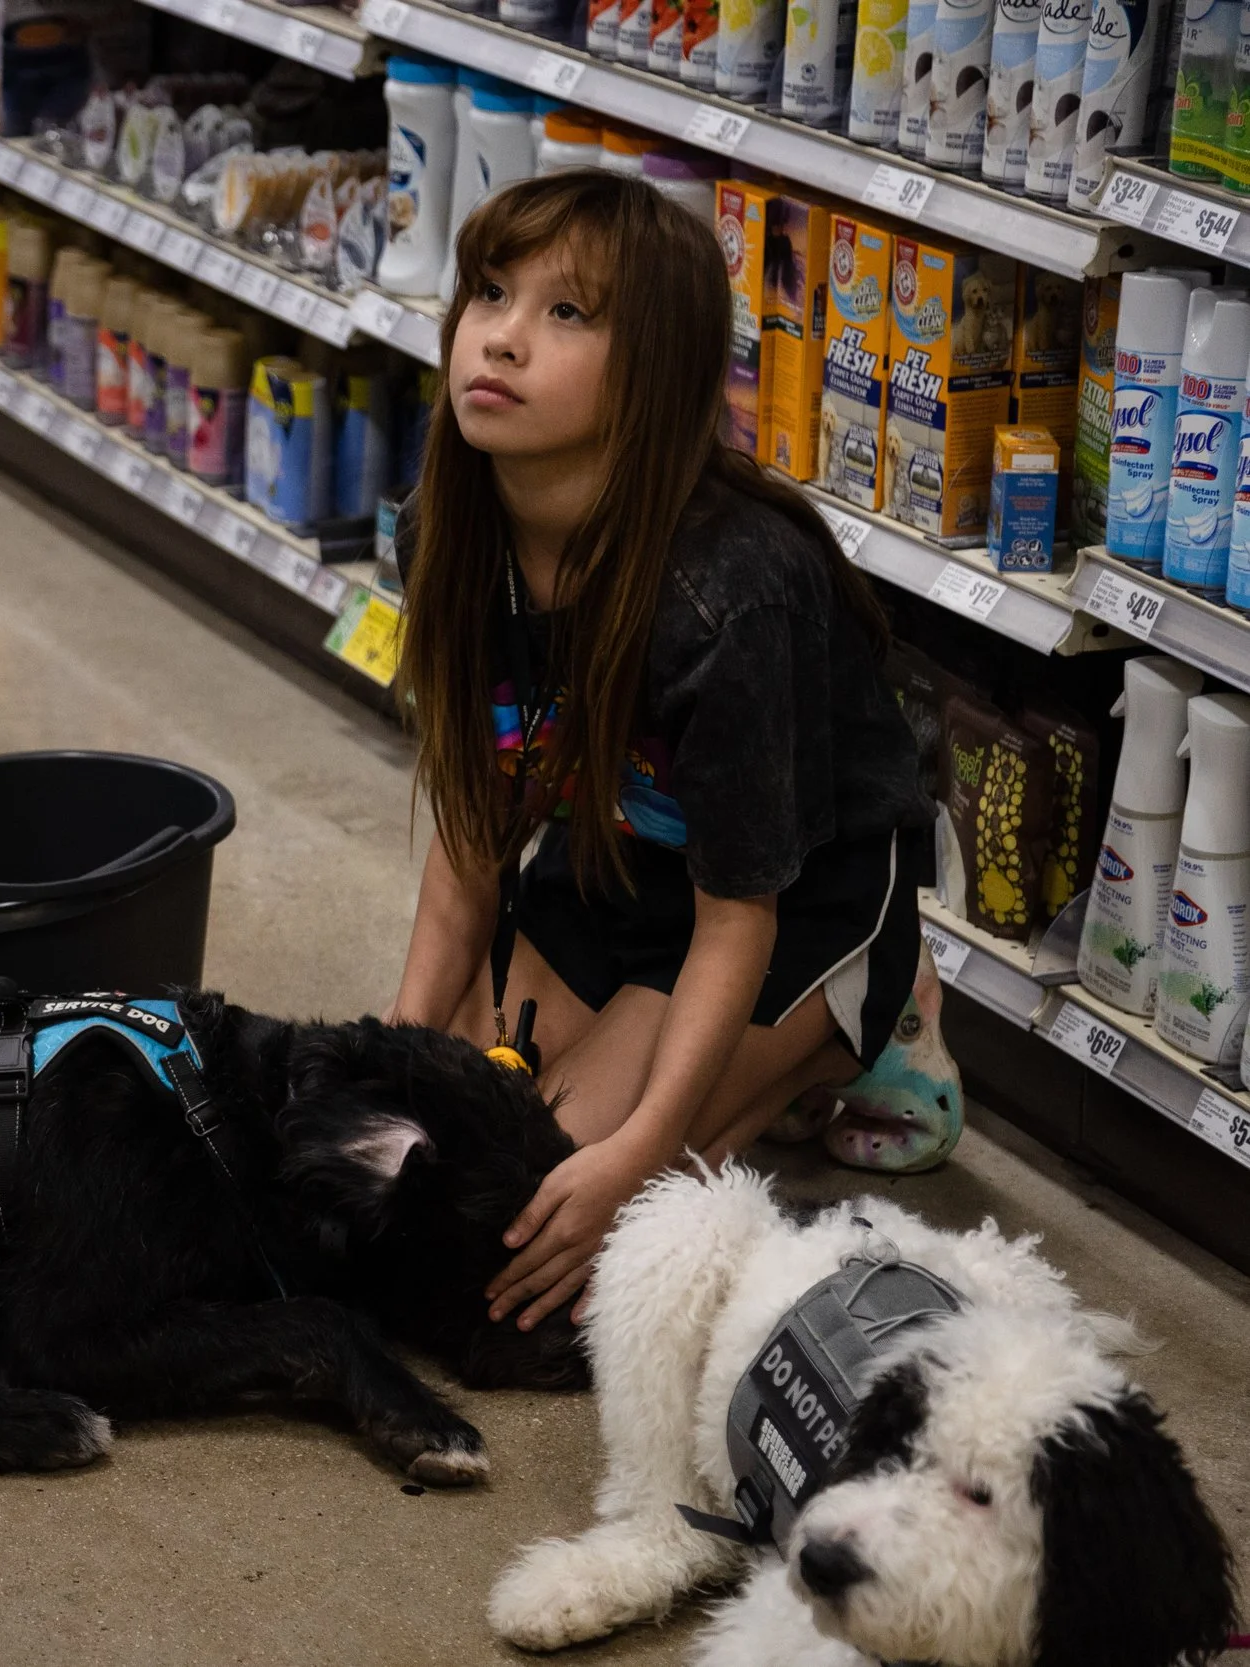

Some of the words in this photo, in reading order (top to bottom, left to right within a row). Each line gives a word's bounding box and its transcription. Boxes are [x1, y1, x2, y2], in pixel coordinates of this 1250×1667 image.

[1111, 175, 1148, 203] $324
[1196, 208, 1234, 238] $544
[841, 325, 866, 349] PET
[827, 338, 877, 377] FRESH
[906, 347, 930, 371] PET
[891, 360, 943, 400] FRESH
[1084, 376, 1111, 411] EXTRA
[1182, 373, 1212, 400] 100
[914, 395, 938, 413] ODOR
[1111, 395, 1157, 435] ysol
[1127, 468, 1154, 480] Spray
[1174, 479, 1220, 497] Disinfectant
[1192, 494, 1219, 506] Spray
[1127, 591, 1159, 621] $478
[1172, 898, 1199, 923] OROX
[42, 1001, 122, 1014] SERVICE
[126, 1008, 171, 1033] DOG
[1086, 1026, 1121, 1058] $682
[762, 1344, 793, 1387] DO
[785, 1375, 827, 1432] NOT
[761, 1416, 793, 1467] SERVICE
